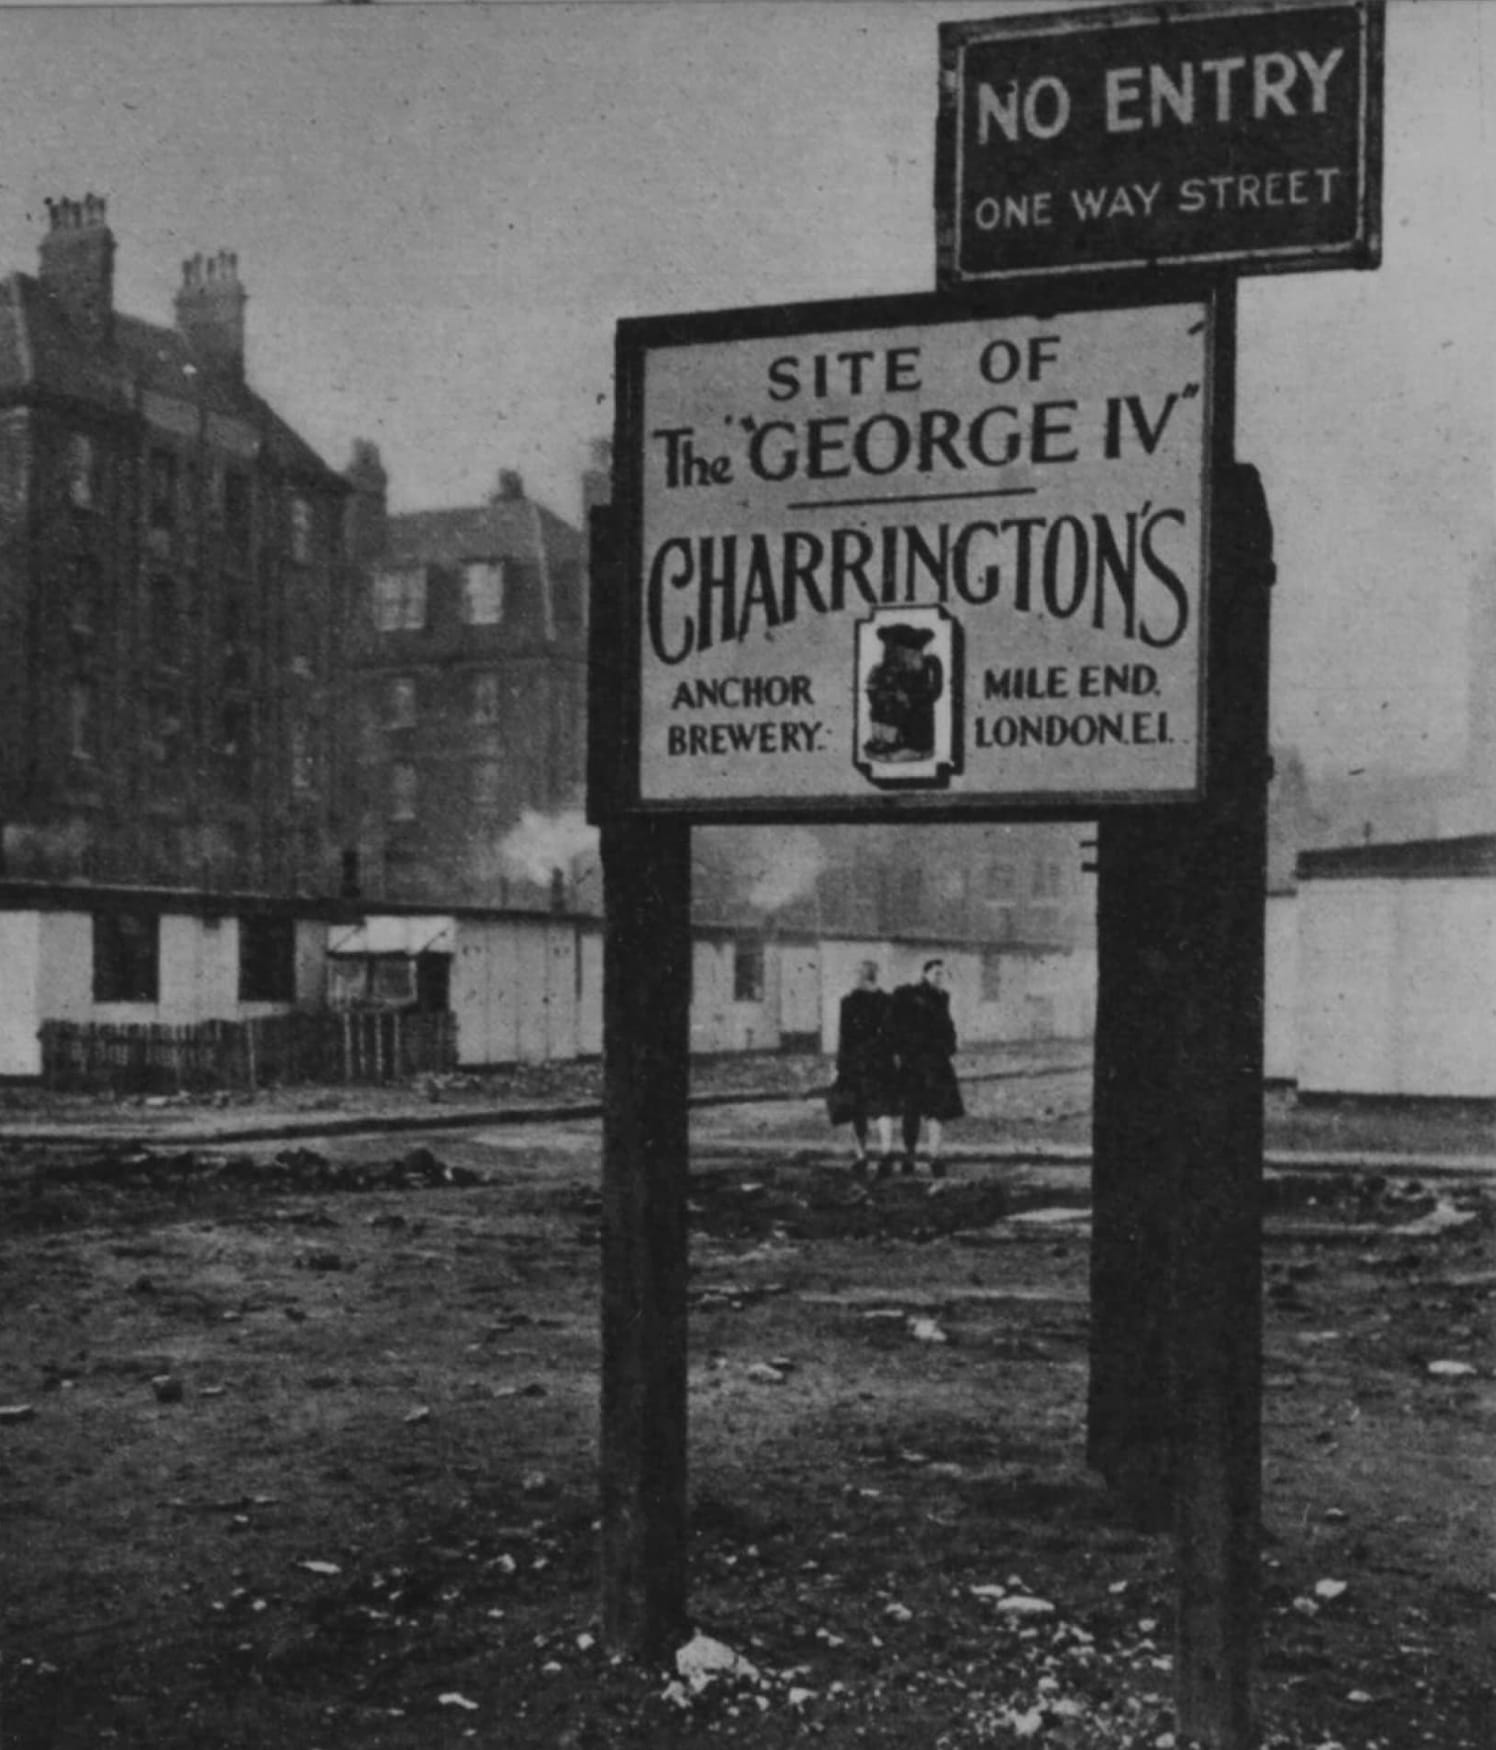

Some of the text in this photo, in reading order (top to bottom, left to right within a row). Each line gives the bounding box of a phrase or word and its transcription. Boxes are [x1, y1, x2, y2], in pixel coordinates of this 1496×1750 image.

[977, 47, 1344, 144] NO ENTRY
[975, 167, 1340, 230] ONE WAY STREET
[767, 336, 1060, 401] SITE OF
[653, 427, 734, 488] The
[648, 500, 1189, 665] CHARRINGTON'S
[671, 675, 815, 710] ANCHOR
[984, 666, 1068, 700] MILE
